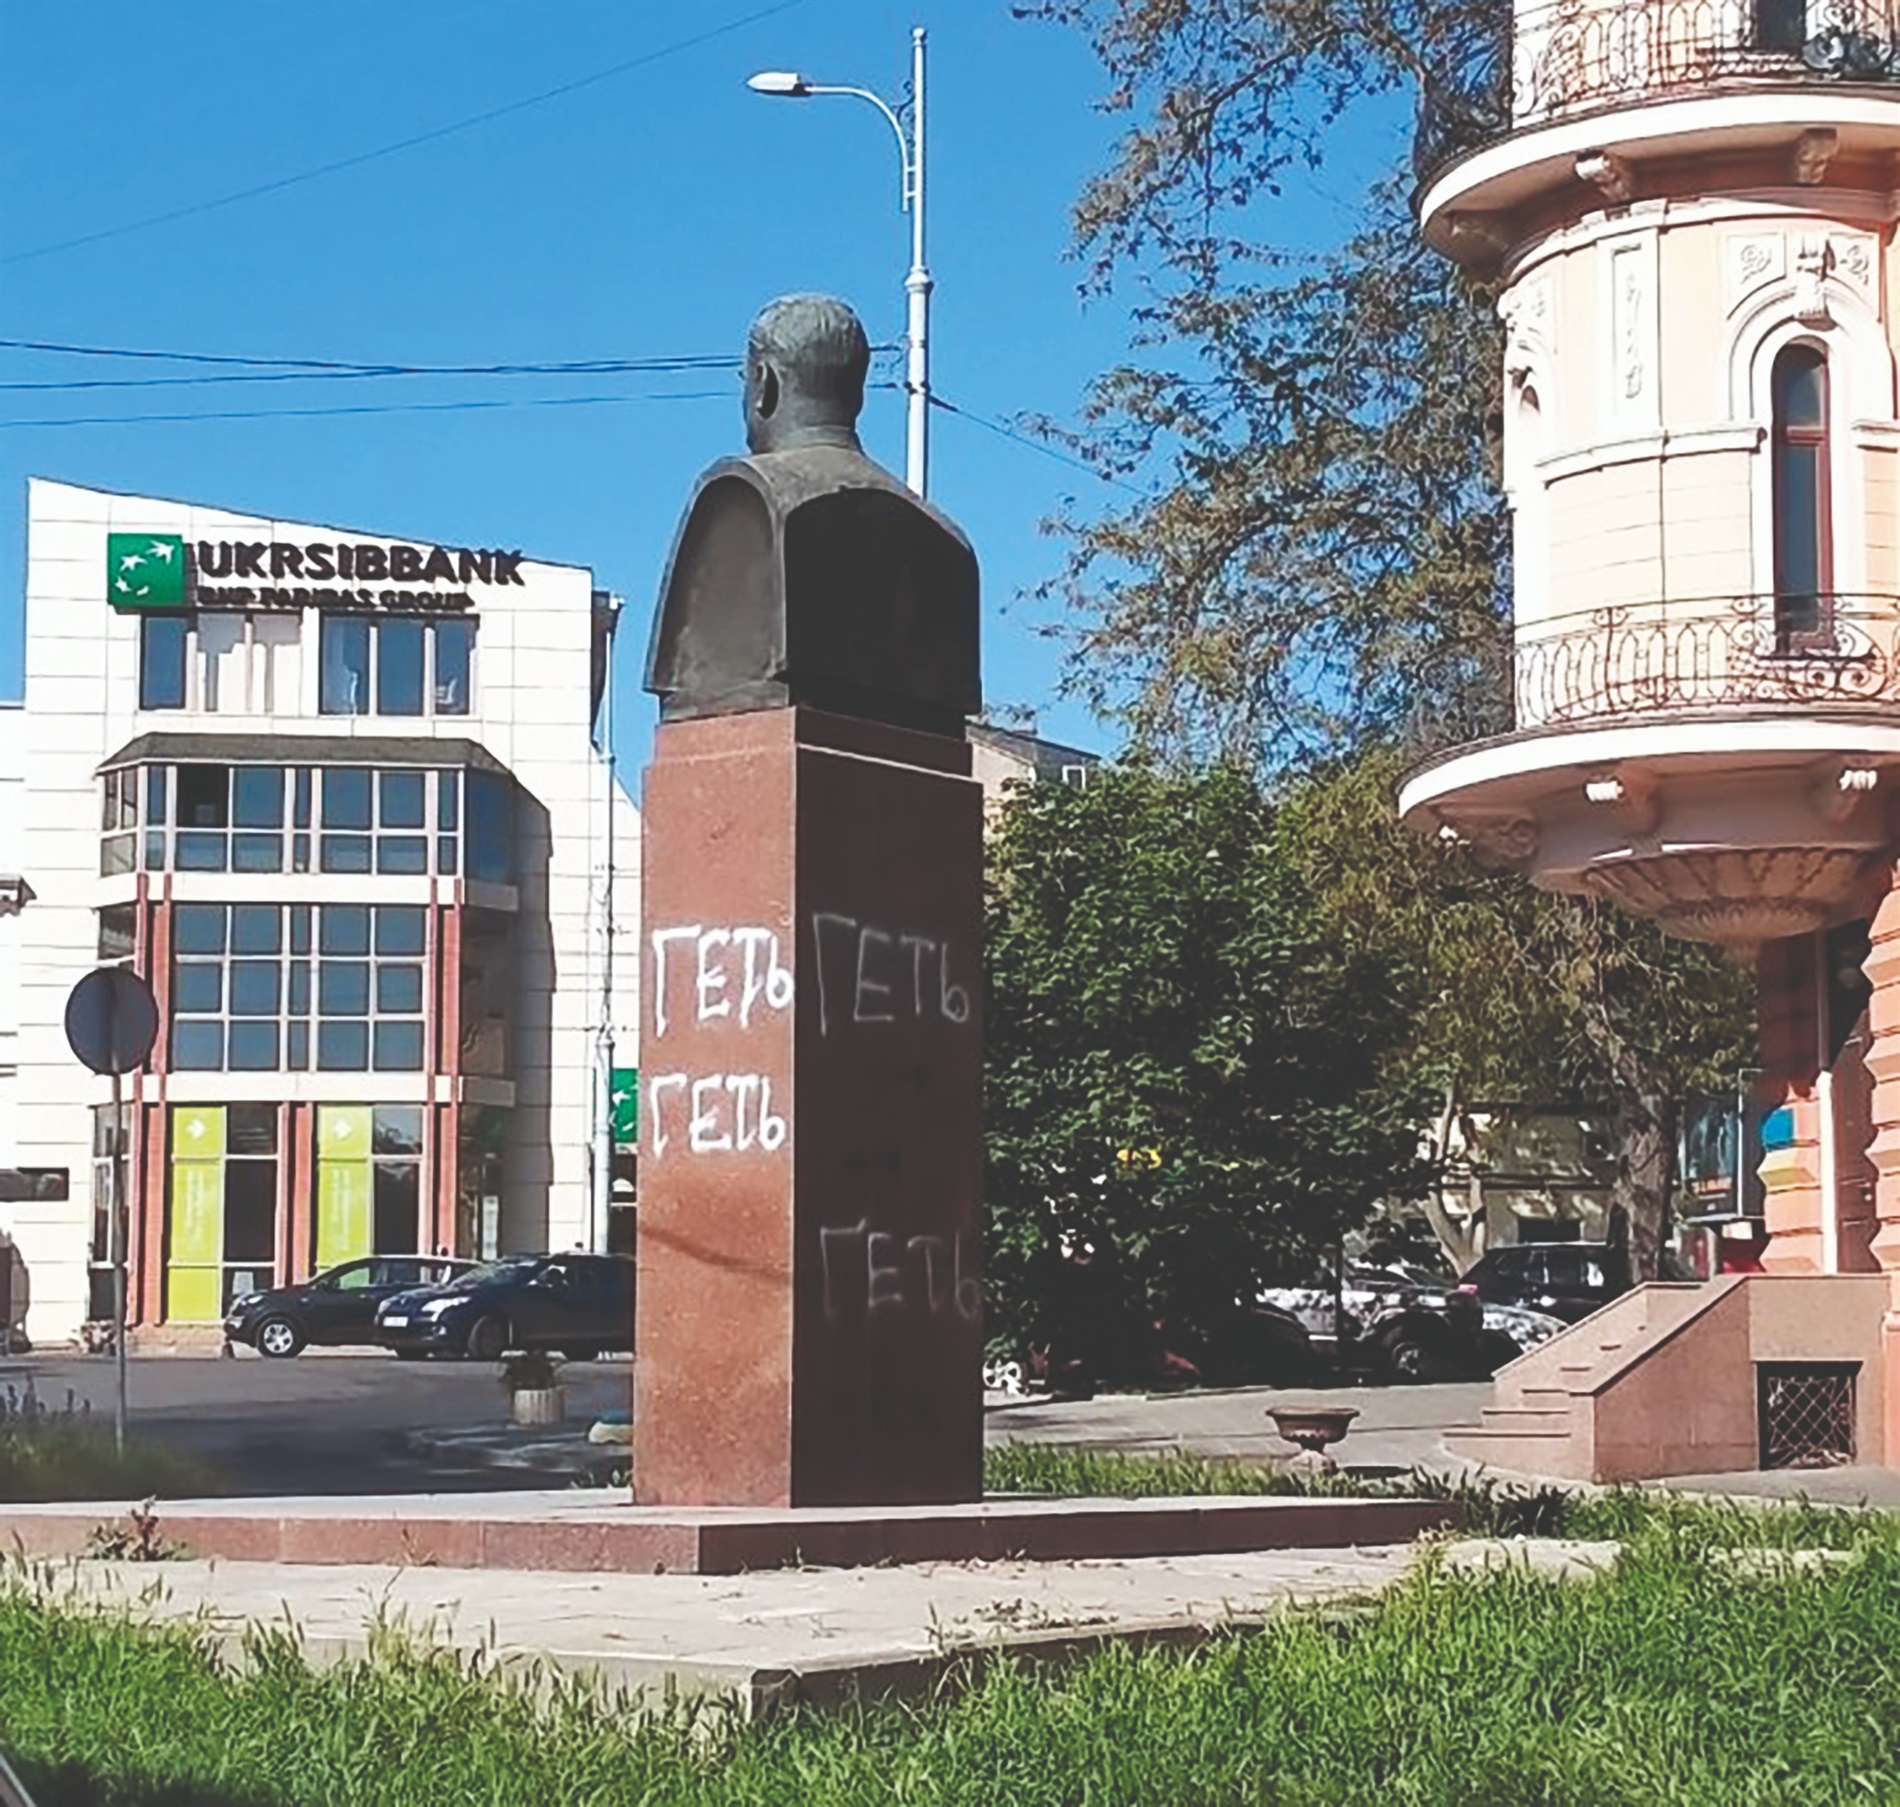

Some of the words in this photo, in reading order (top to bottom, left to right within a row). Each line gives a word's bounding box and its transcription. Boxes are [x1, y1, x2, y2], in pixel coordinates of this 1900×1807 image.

[197, 541, 525, 586] UKRSIBBANK
[652, 924, 795, 1038] ГЕТЬ
[812, 912, 970, 1037] ГЕТЬ
[650, 1073, 786, 1158] ГЕТЬ
[820, 1217, 983, 1320] ГЕТЬ
